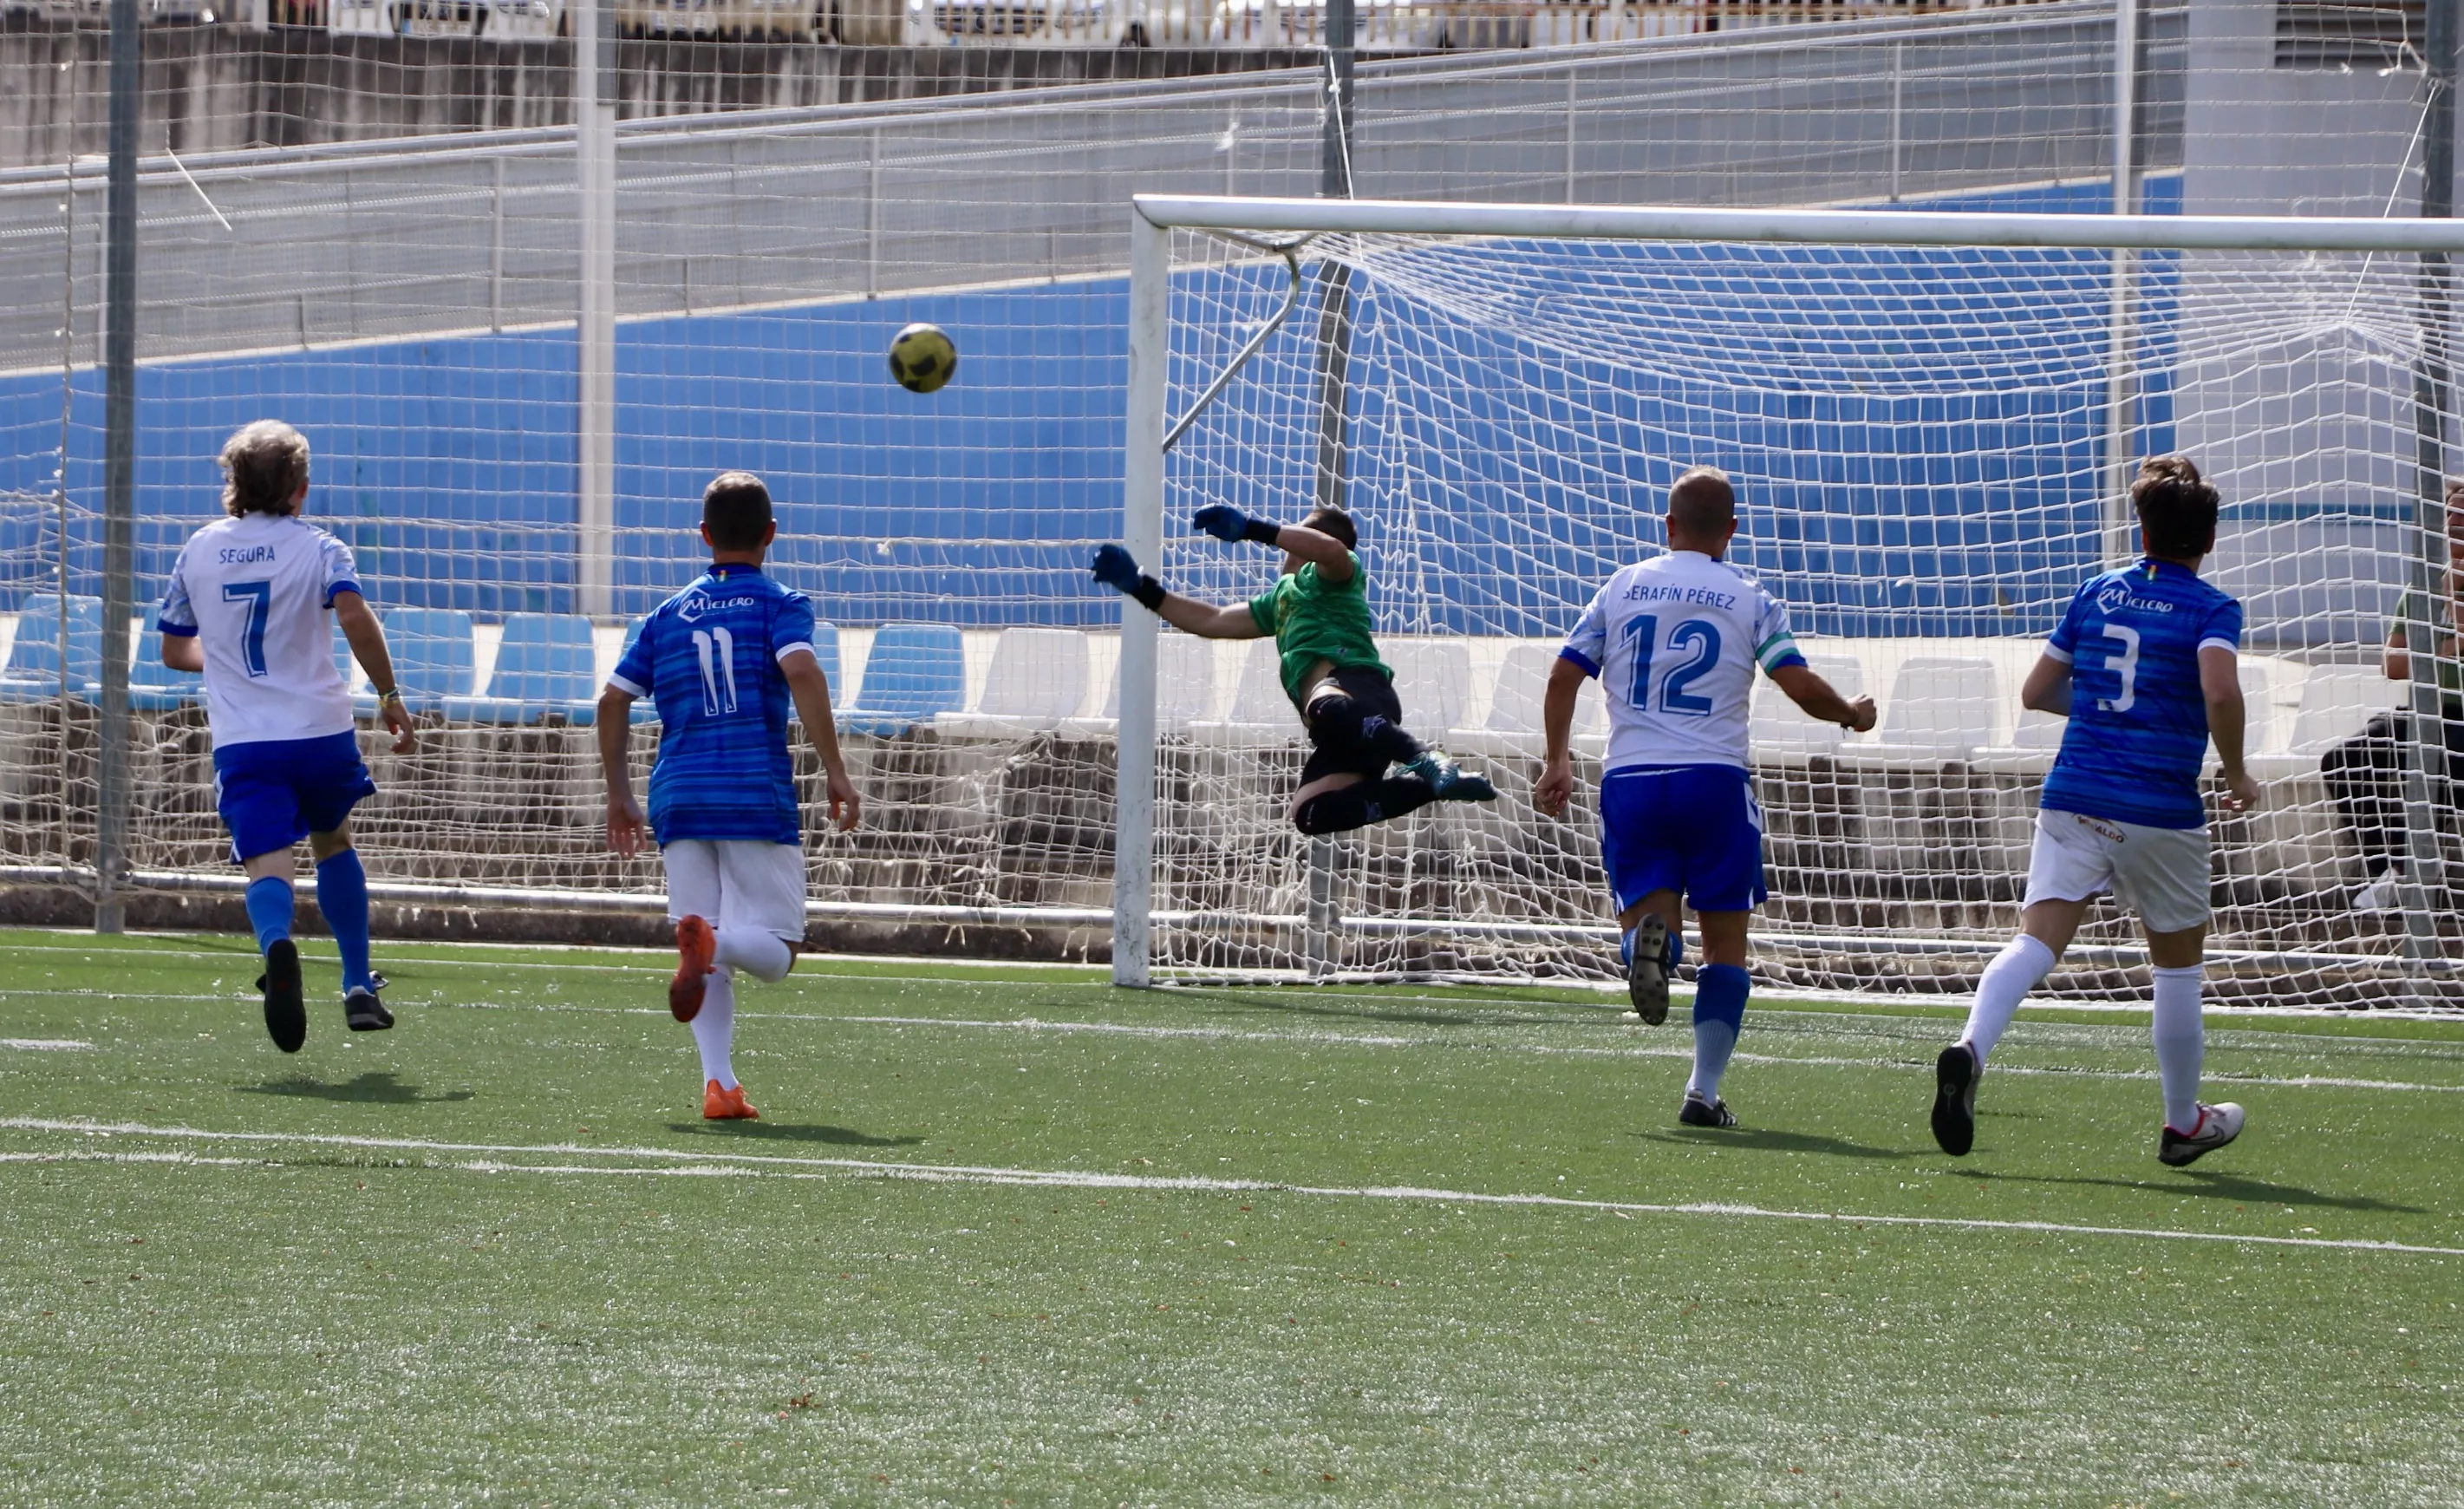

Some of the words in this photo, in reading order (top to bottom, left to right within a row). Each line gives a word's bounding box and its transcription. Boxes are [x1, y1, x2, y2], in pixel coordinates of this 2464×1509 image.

[218, 545, 276, 565] SEGURA
[1685, 585, 1737, 611] PÉREZ
[222, 580, 271, 678] 7
[692, 626, 737, 717] 11
[1619, 614, 1722, 717] 12
[2096, 623, 2141, 713] 3
